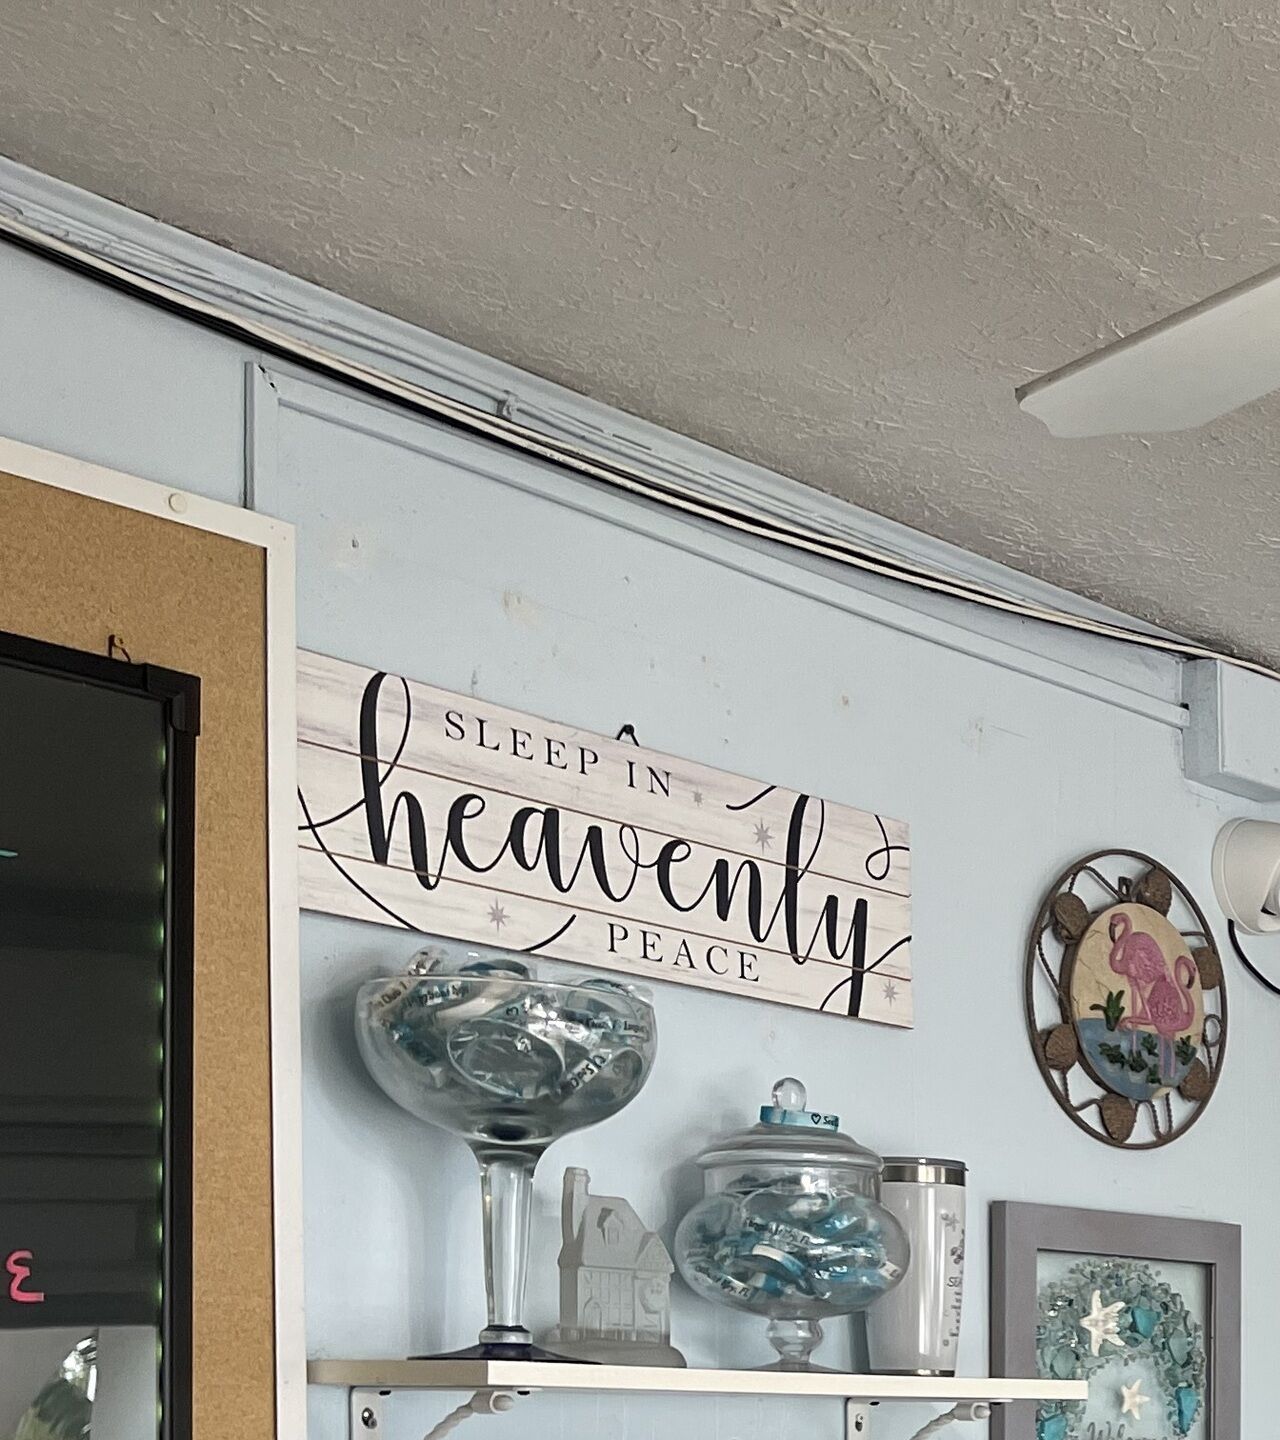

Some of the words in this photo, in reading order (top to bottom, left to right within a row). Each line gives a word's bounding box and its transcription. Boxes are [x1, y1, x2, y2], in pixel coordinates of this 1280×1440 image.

[444, 711, 599, 775] SLEEP
[627, 761, 673, 798] IN
[359, 671, 882, 1015] heavenly
[607, 924, 762, 982] PEACE
